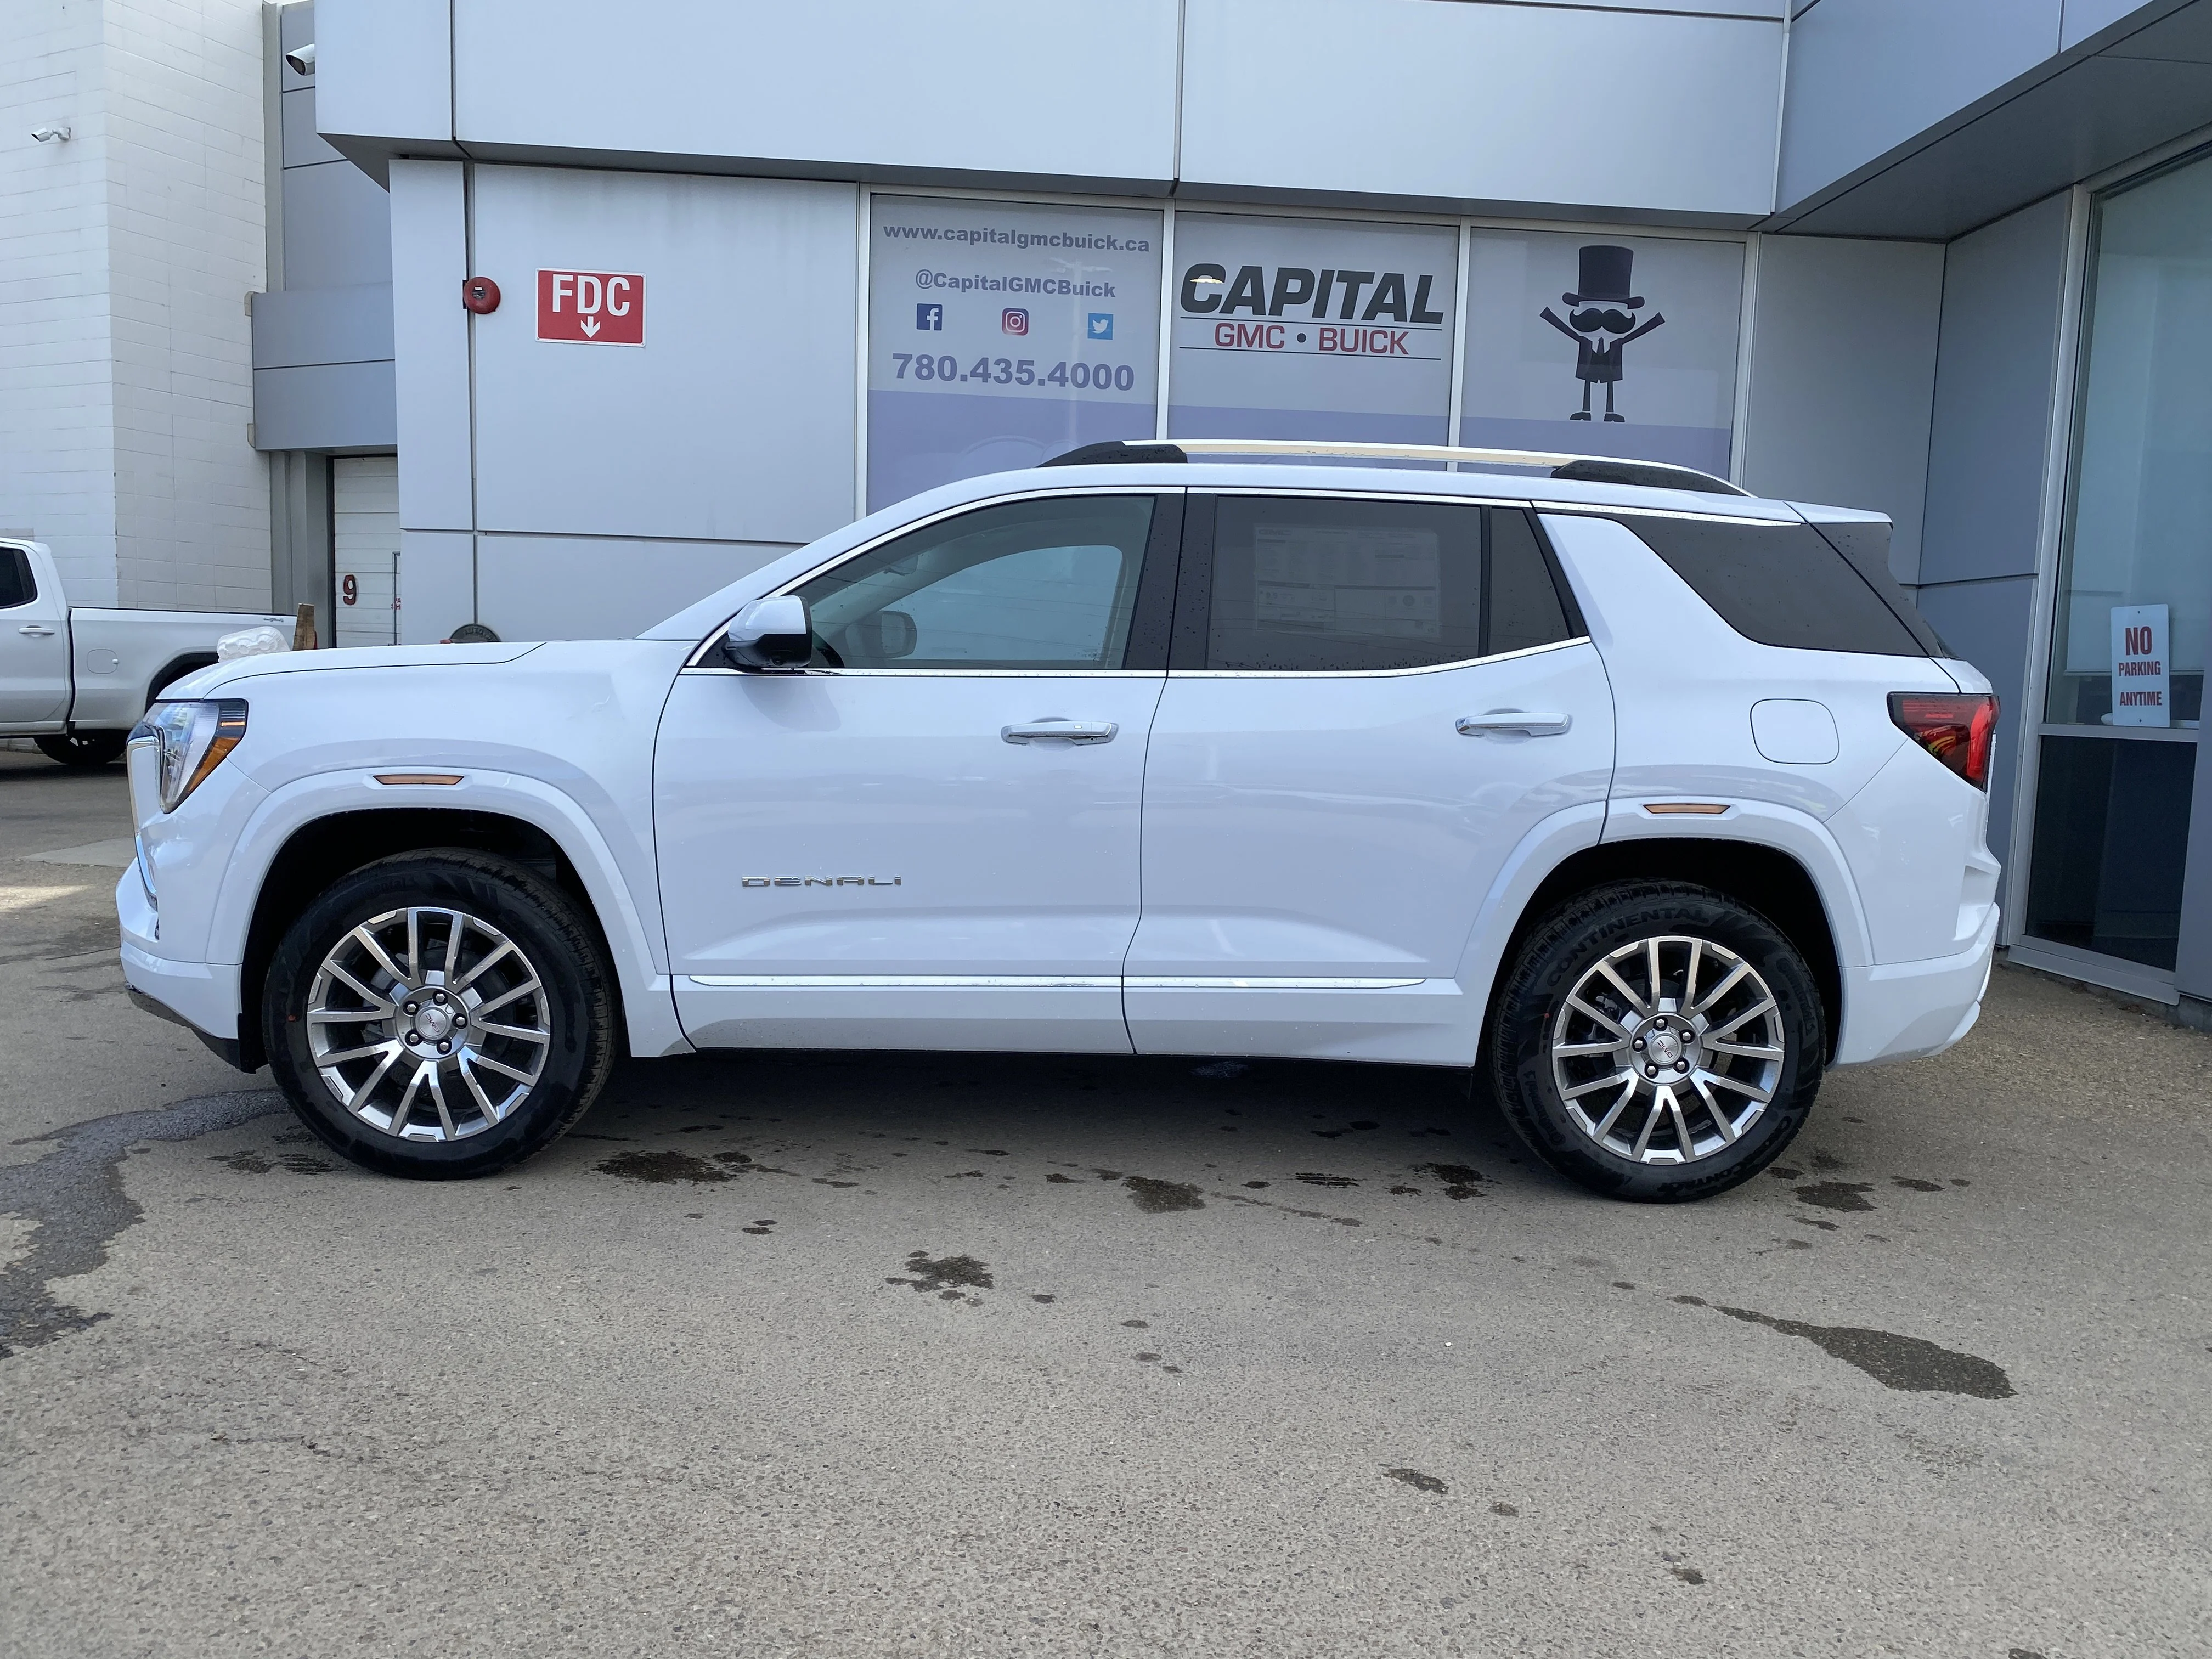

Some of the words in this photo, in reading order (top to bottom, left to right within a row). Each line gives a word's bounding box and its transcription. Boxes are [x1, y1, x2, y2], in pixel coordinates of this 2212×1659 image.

[883, 225, 1150, 252] www.capitalgmcbuick.ca
[551, 274, 630, 317] FDC
[915, 269, 1116, 298] @CapitalGMCBuick
[1180, 263, 1444, 325] CAPITAL
[1215, 323, 1285, 349] GMC
[1319, 327, 1409, 355] BUICK
[891, 353, 1135, 391] 780.435.4000
[342, 574, 357, 606] 9
[2125, 625, 2153, 656] NO
[2118, 661, 2162, 677] PARKING
[2119, 691, 2163, 706] ANYTIME
[742, 874, 902, 887] DENALI
[1547, 907, 1709, 988] CONTINENTAL
[424, 1013, 441, 1033] GMC
[1657, 1040, 1673, 1058] GMC
